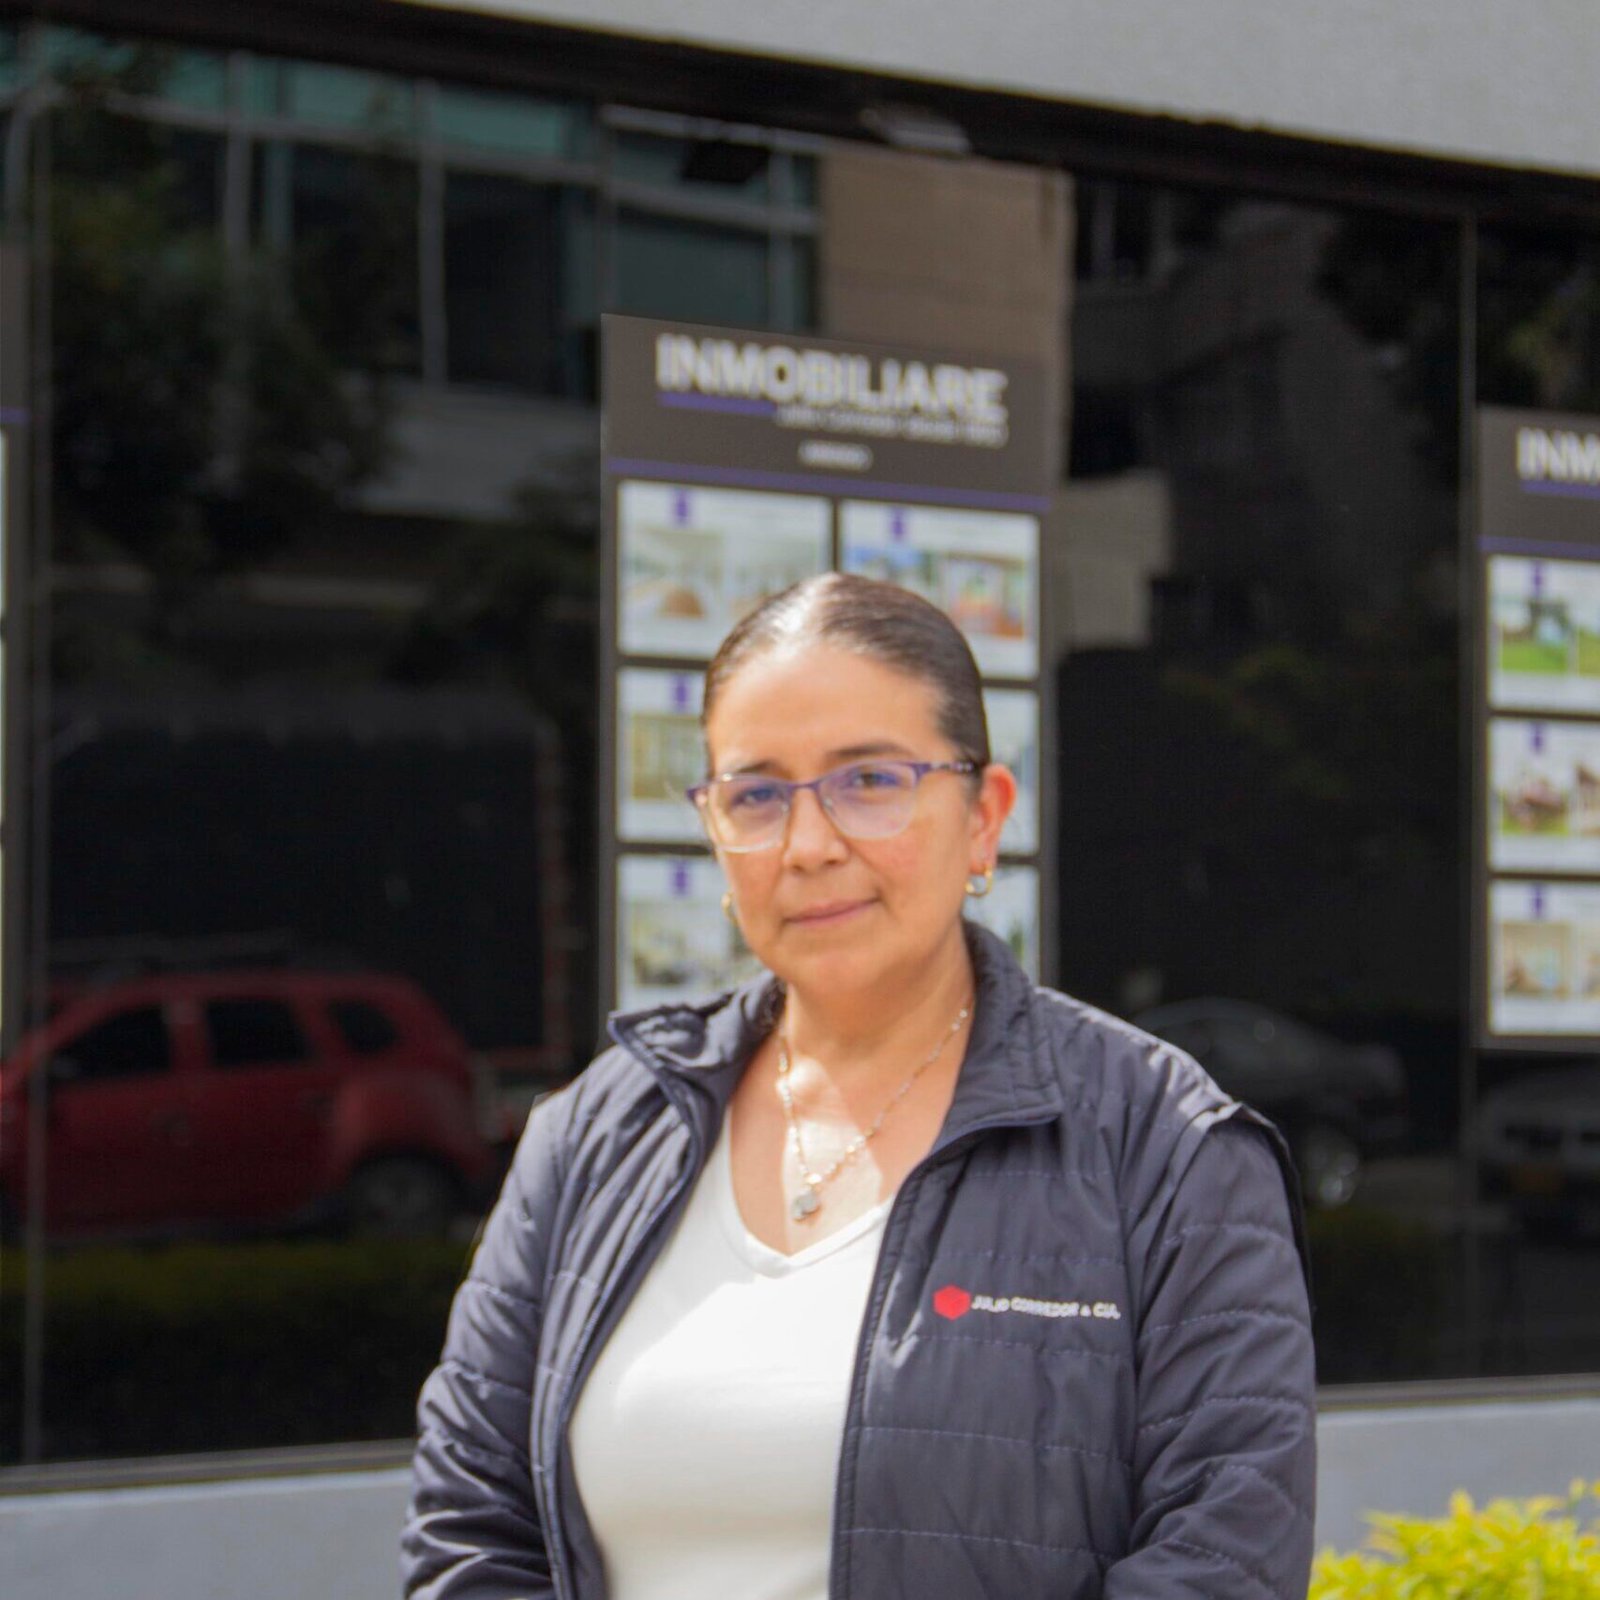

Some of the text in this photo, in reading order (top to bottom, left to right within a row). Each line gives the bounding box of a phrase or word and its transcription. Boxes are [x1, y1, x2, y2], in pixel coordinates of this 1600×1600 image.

[656, 333, 1008, 423] INMOBILIARE
[971, 1295, 1010, 1313] JULIO
[1011, 1297, 1079, 1317] CORREDOR
